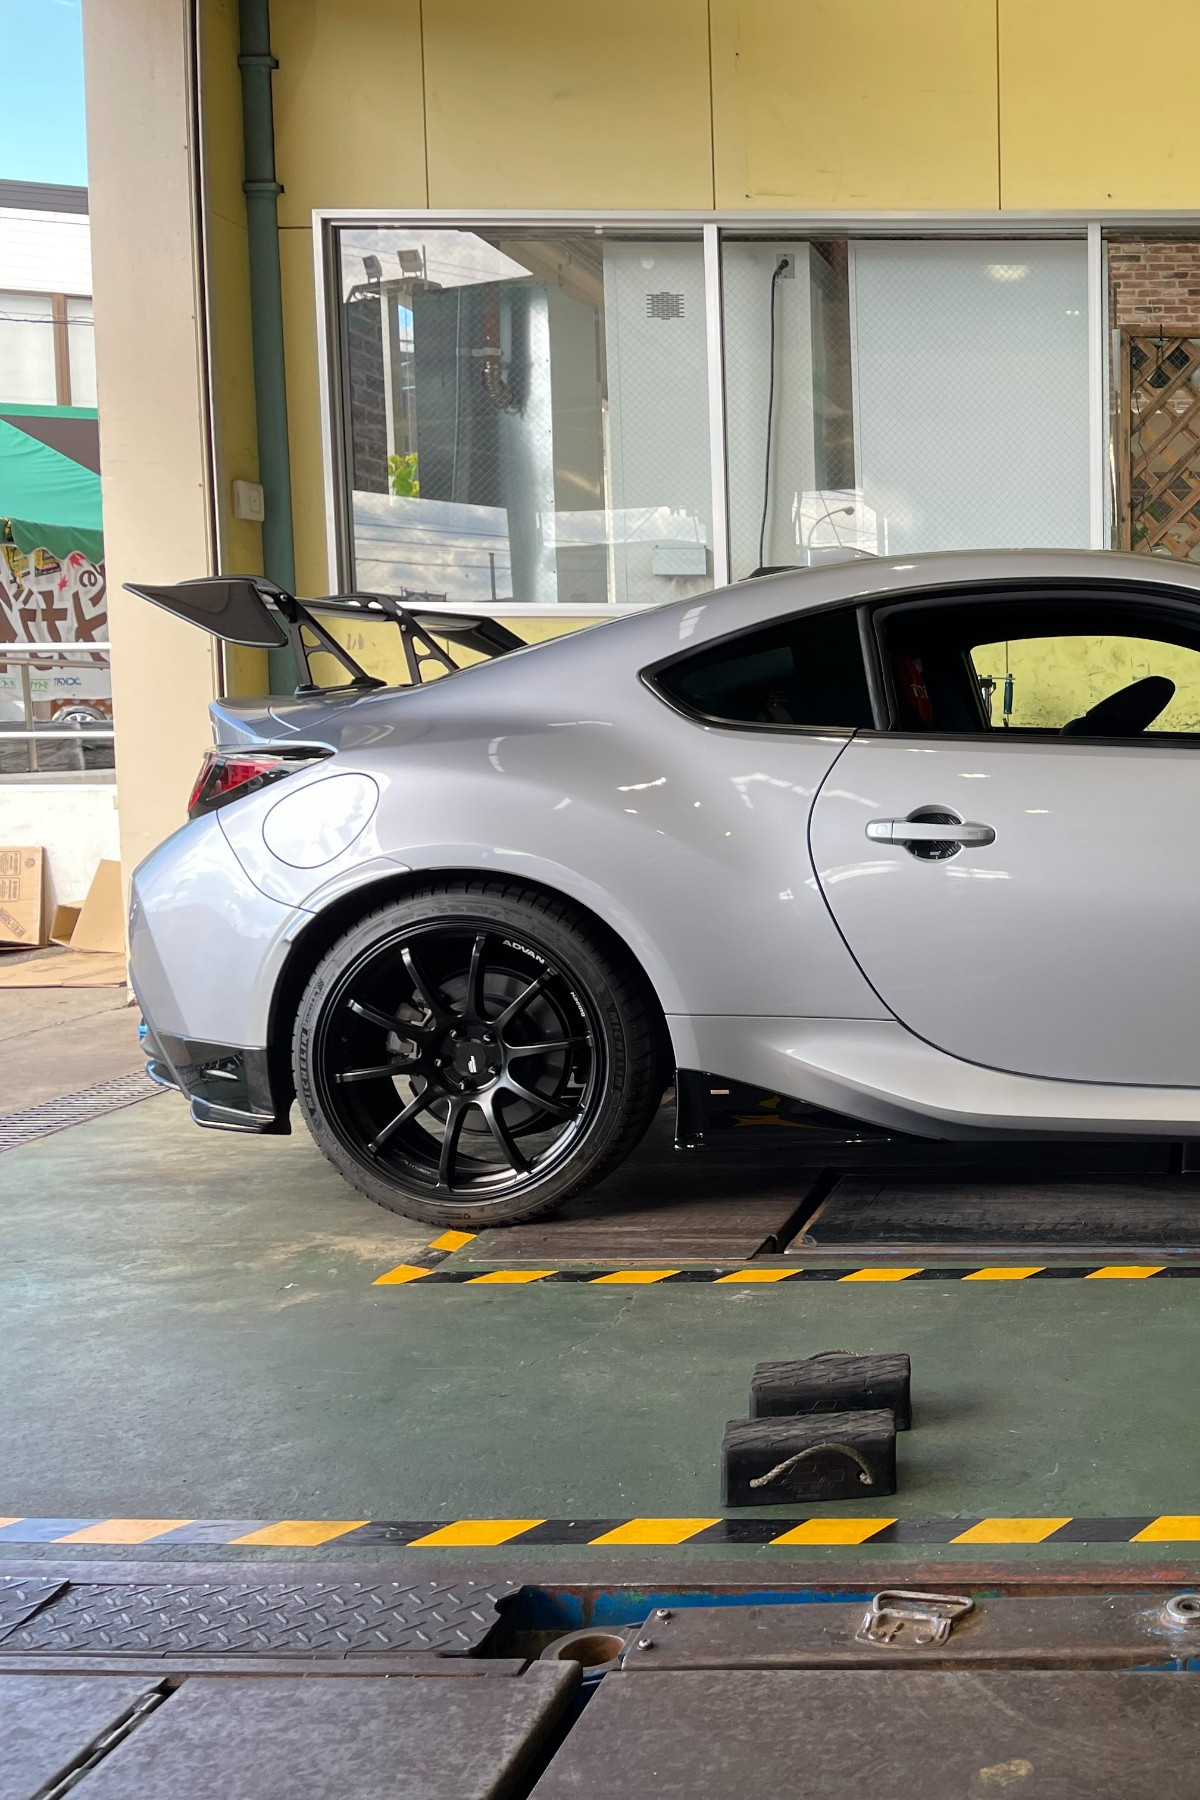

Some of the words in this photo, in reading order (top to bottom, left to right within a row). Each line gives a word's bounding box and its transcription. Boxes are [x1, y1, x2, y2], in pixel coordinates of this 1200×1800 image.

[503, 940, 545, 965] ADVAN
[301, 1032, 314, 1108] MICHELIN
[608, 1011, 626, 1087] MICHELIN
